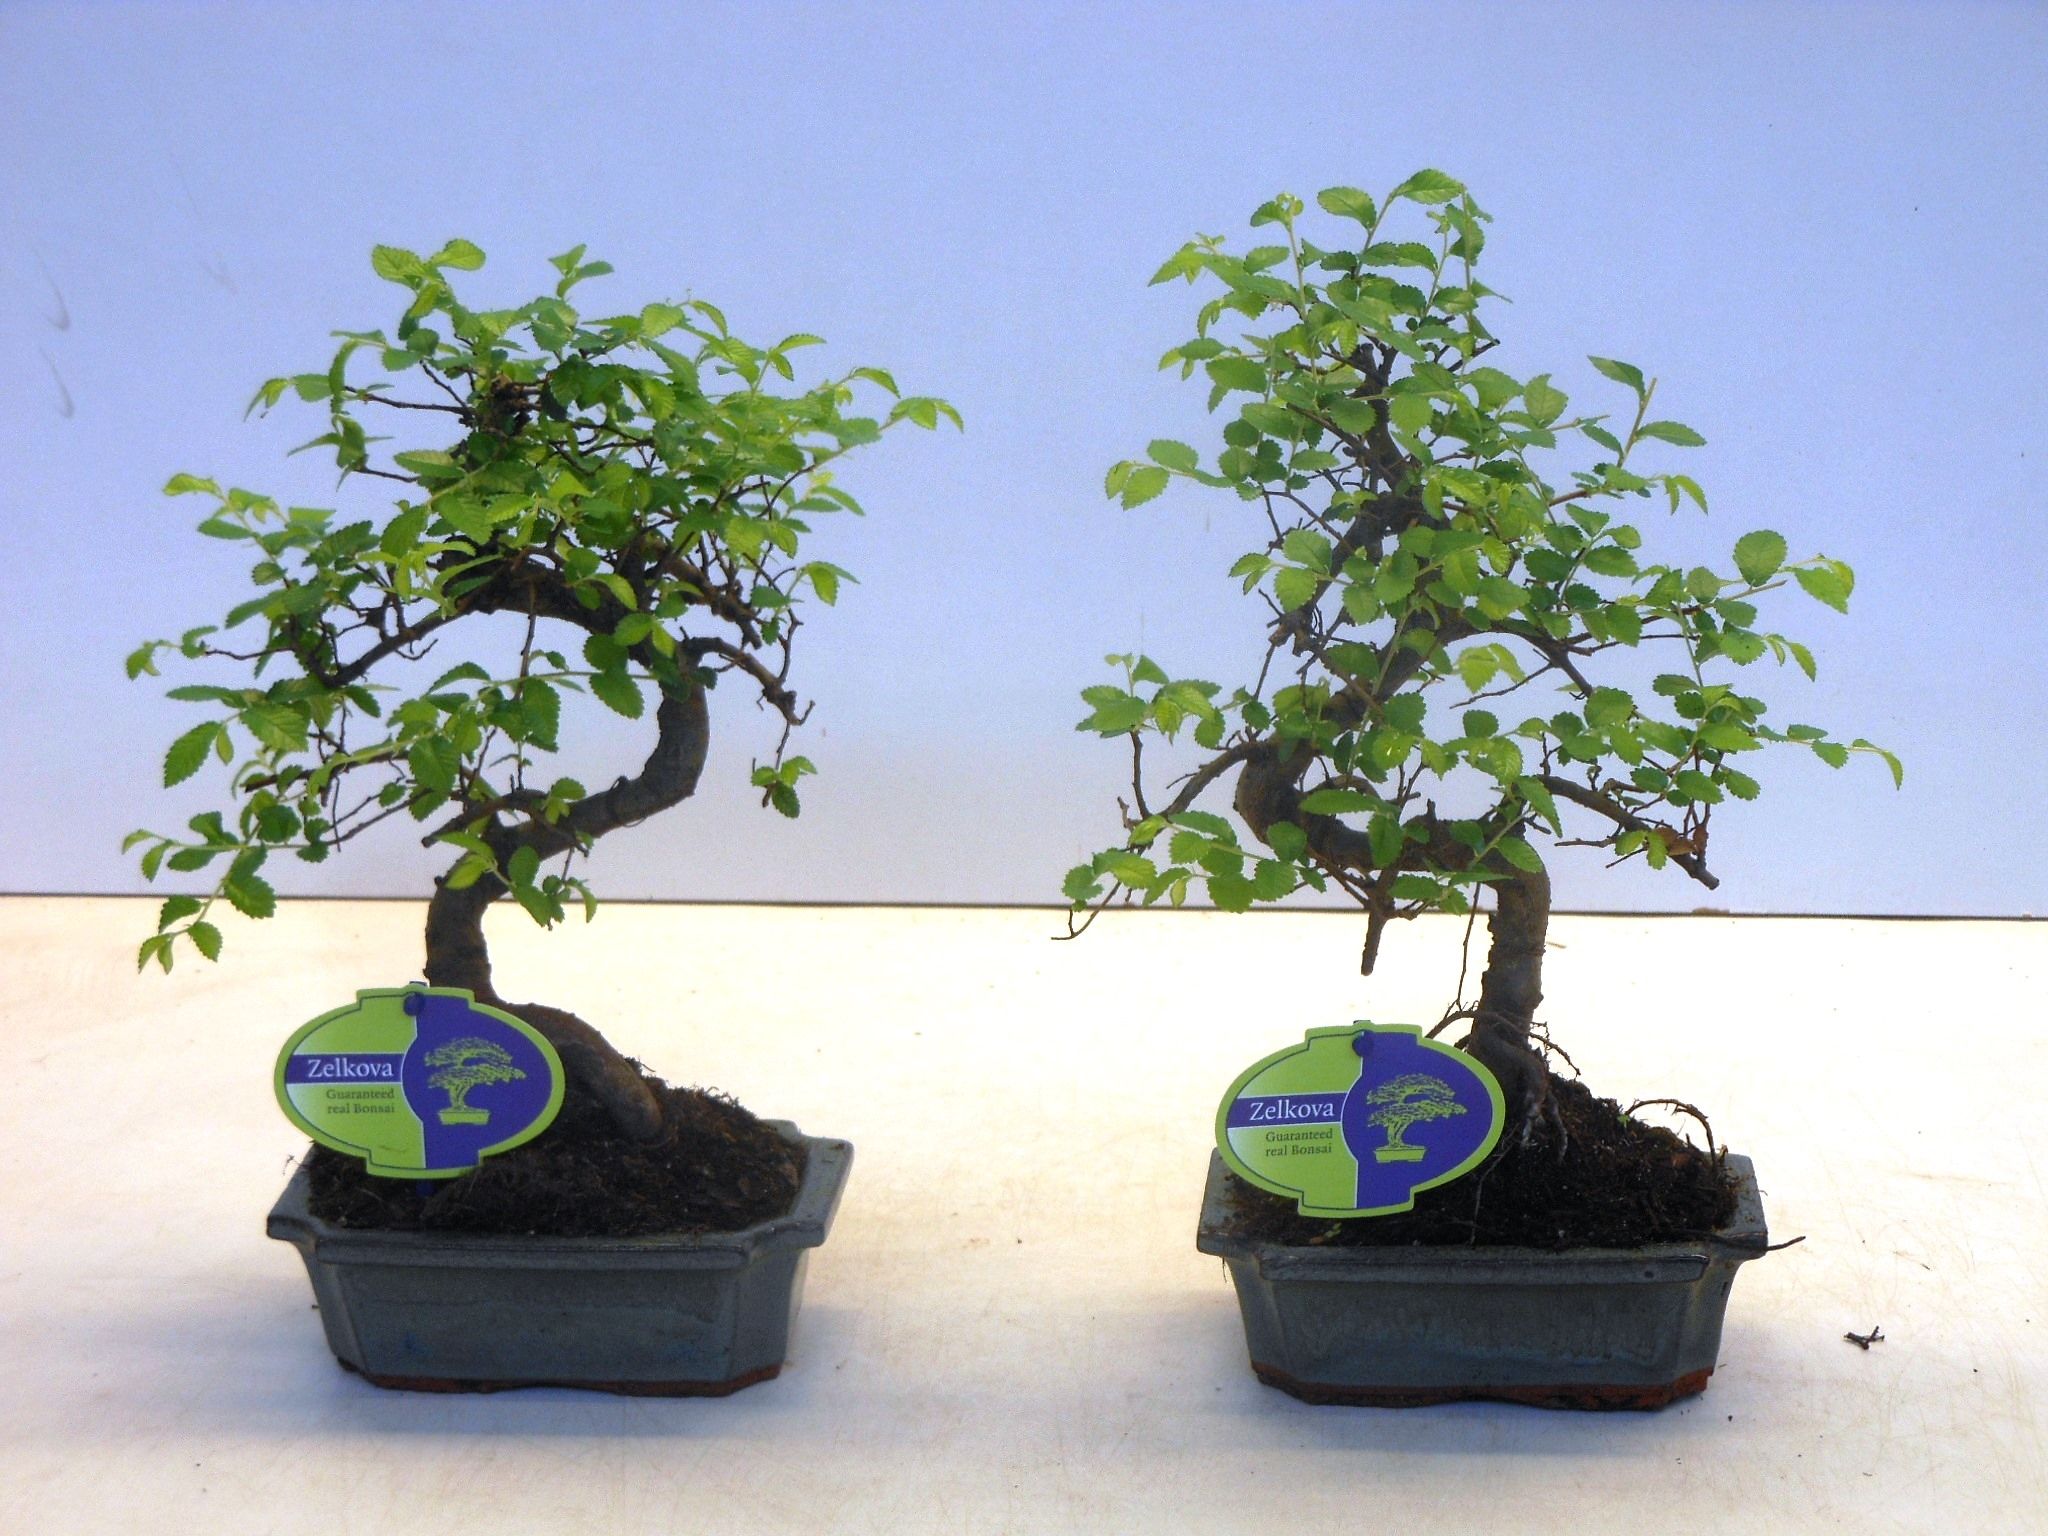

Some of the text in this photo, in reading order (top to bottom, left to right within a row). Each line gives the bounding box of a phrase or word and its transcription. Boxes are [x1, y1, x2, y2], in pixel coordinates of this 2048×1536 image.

[307, 1058, 394, 1078] Zelkova
[325, 1088, 395, 1100] Guaranteed
[327, 1102, 395, 1114] real Bonsai
[1249, 1100, 1335, 1121] Zelkova
[1265, 1128, 1333, 1143] Guaranteed
[1265, 1142, 1332, 1157] real Bonsai
